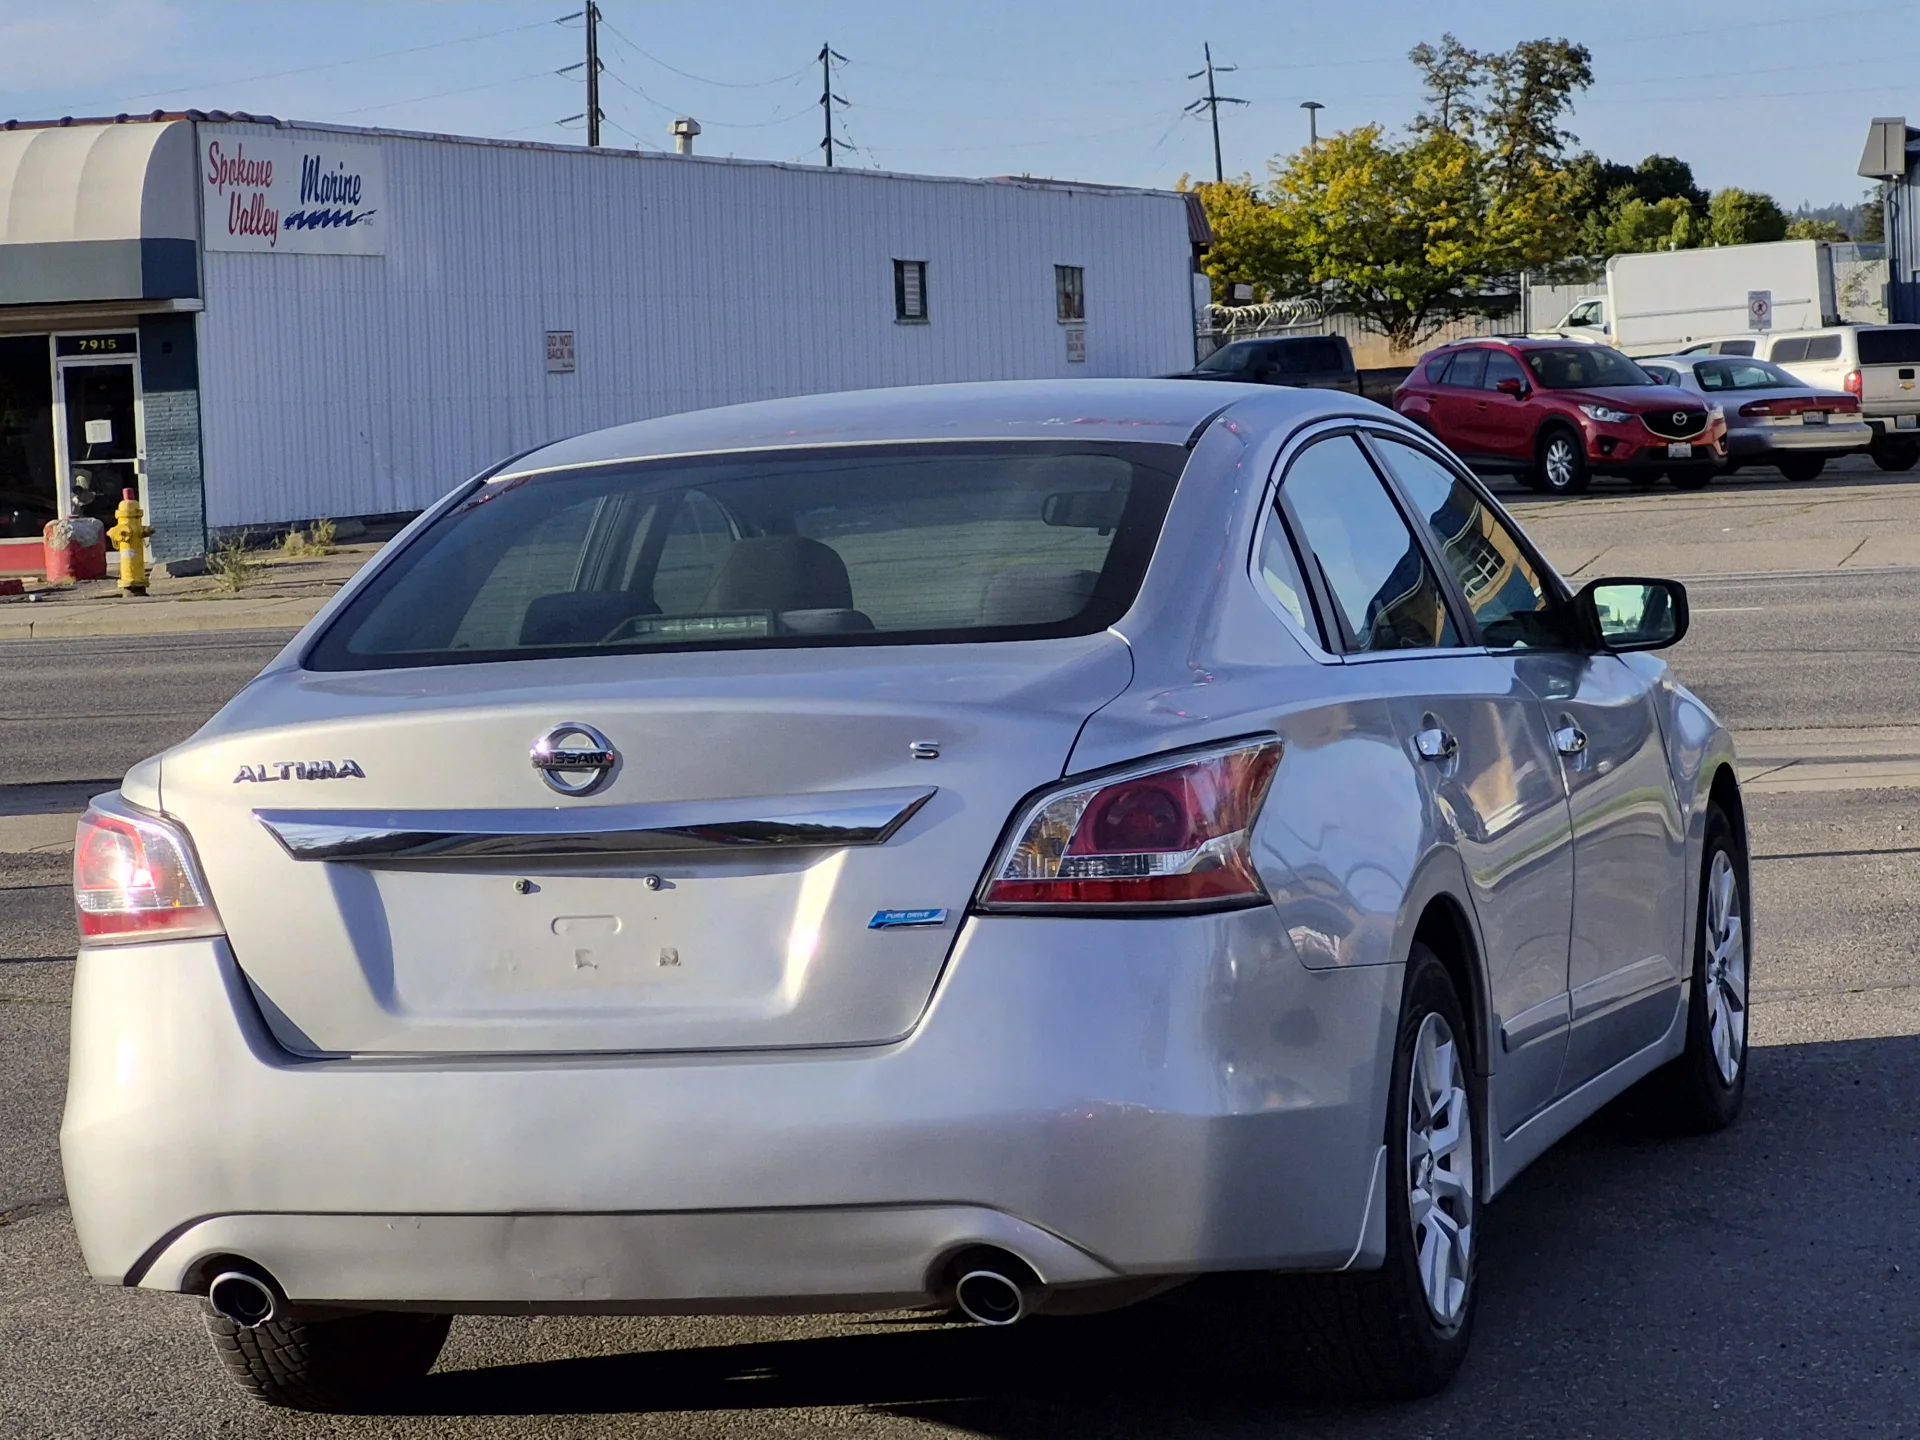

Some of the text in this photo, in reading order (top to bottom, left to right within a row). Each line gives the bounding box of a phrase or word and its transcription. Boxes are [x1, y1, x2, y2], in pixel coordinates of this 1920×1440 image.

[208, 141, 272, 196] Spokane
[300, 154, 362, 206] Marine
[228, 191, 279, 248] Valley
[79, 339, 117, 350] 7915
[909, 740, 940, 760] S
[232, 758, 366, 784] ALTIMA
[885, 911, 930, 920] PURE DRIVE
